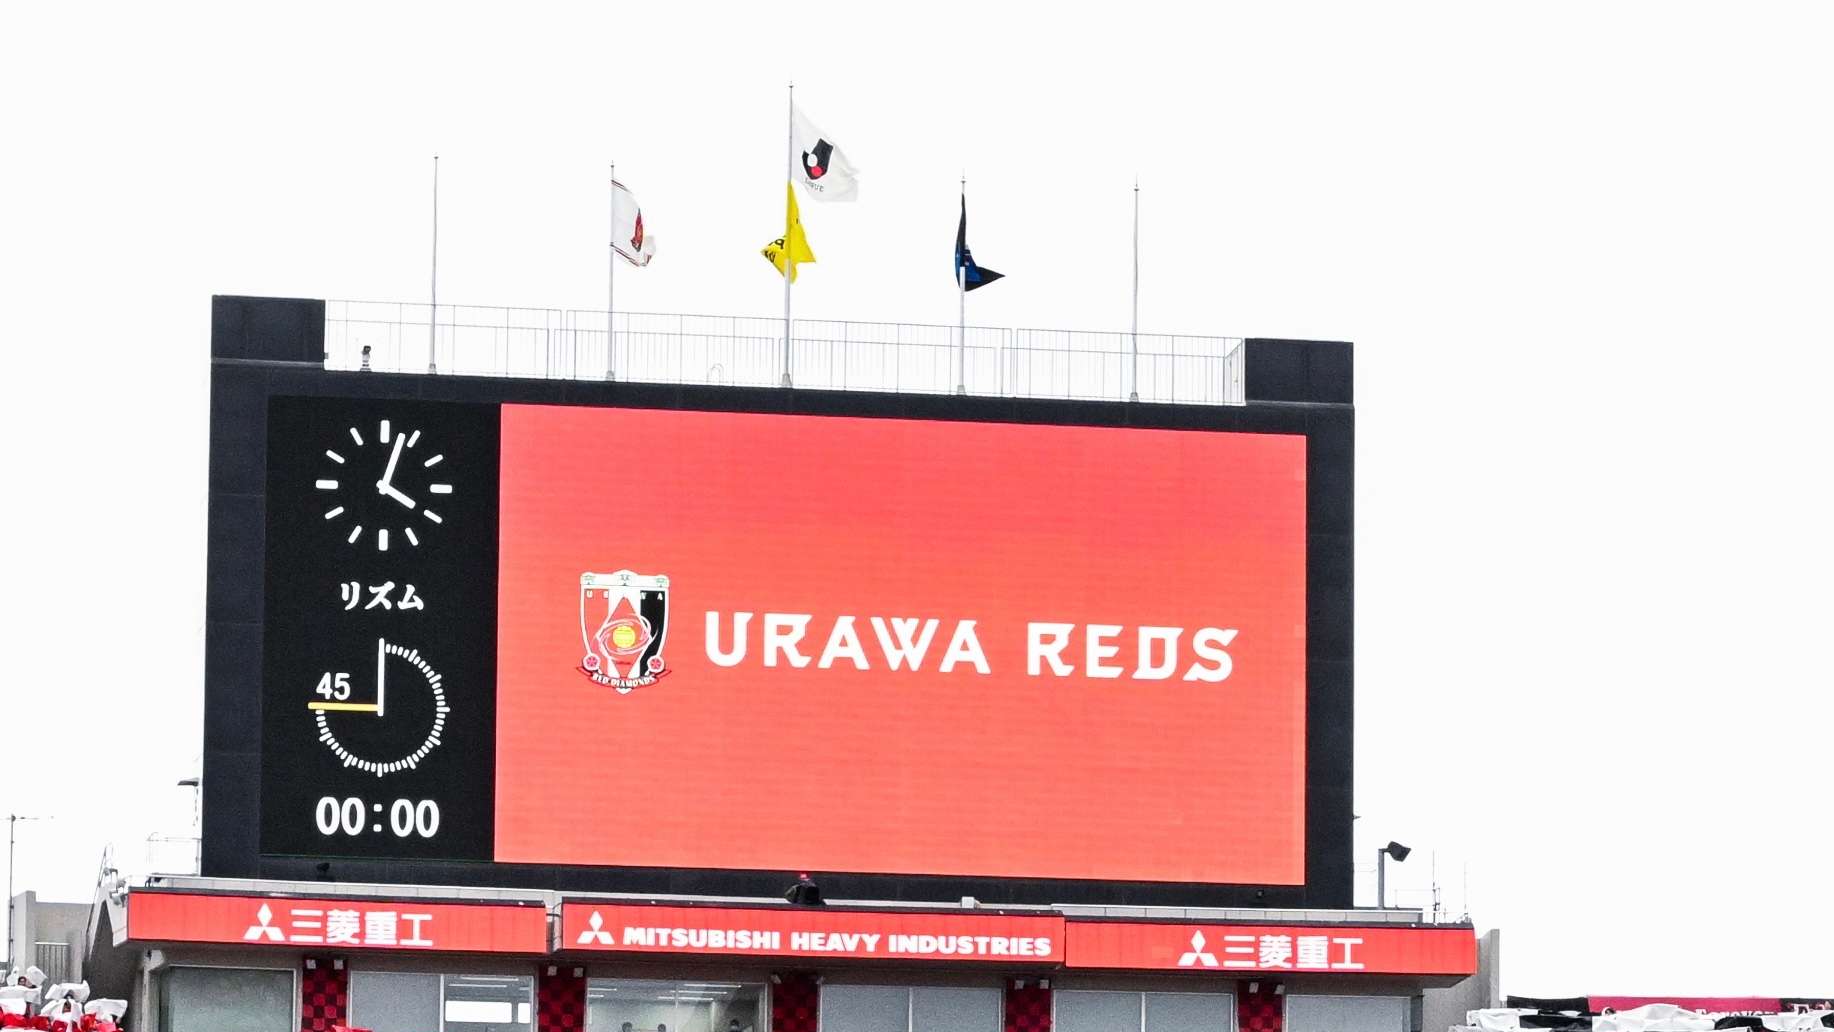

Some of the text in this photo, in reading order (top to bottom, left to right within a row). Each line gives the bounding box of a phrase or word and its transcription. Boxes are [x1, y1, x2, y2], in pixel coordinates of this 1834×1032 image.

[341, 581, 424, 611] リズム
[704, 611, 1239, 683] URAWA REDS
[316, 672, 351, 700] 45
[315, 796, 440, 838] 00:00
[290, 909, 433, 947] 三菱重工
[622, 926, 1052, 957] MITSUBISHI HEAVY INDUSTRIES
[1223, 934, 1365, 970] 三菱重工
